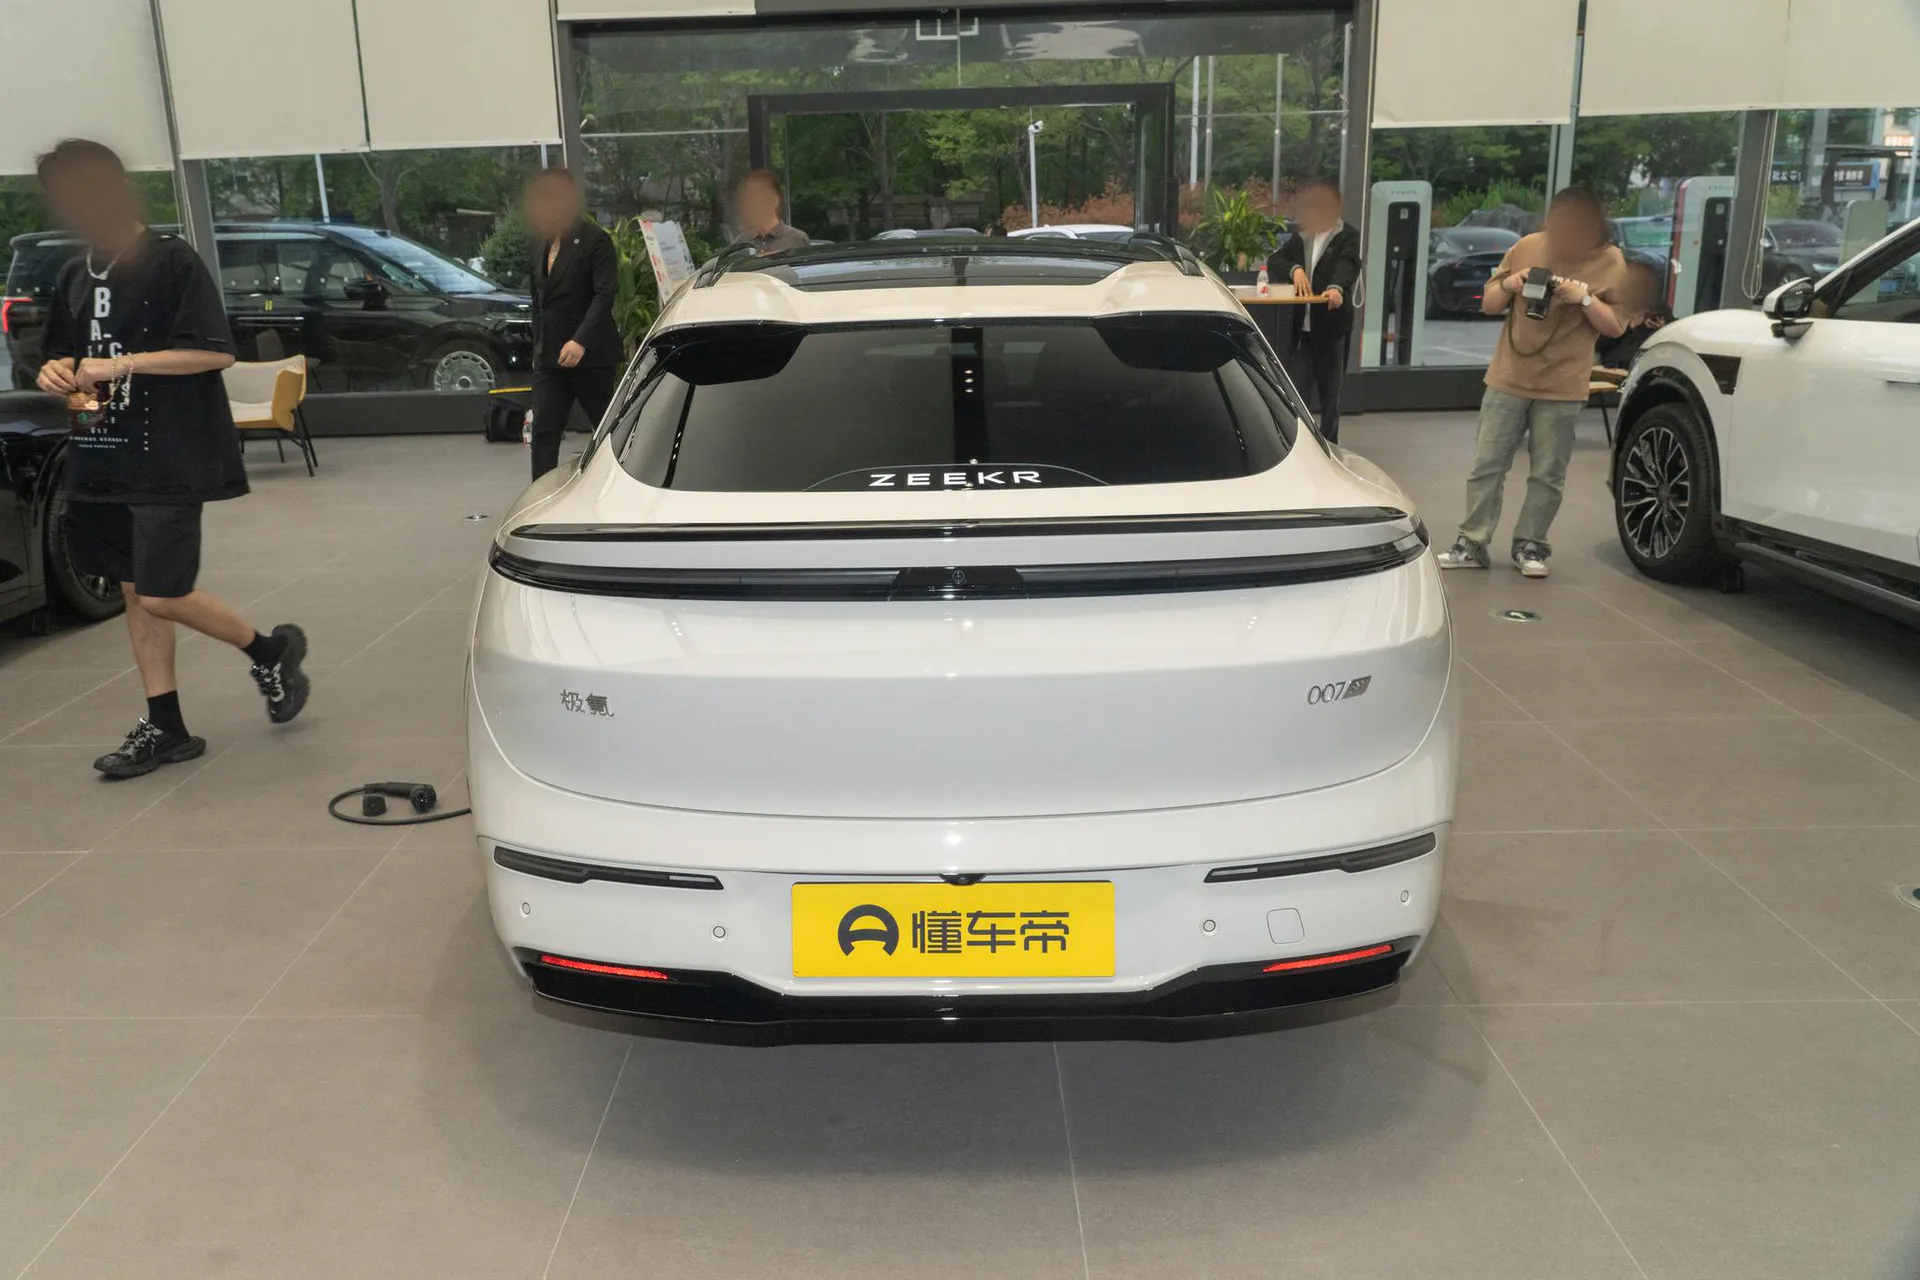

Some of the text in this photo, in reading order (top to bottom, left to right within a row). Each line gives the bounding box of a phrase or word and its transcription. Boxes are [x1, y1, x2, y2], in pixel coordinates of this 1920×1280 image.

[94, 287, 111, 318] B
[868, 471, 1042, 487] ZEEKR
[912, 910, 1070, 954] 懂车帝
